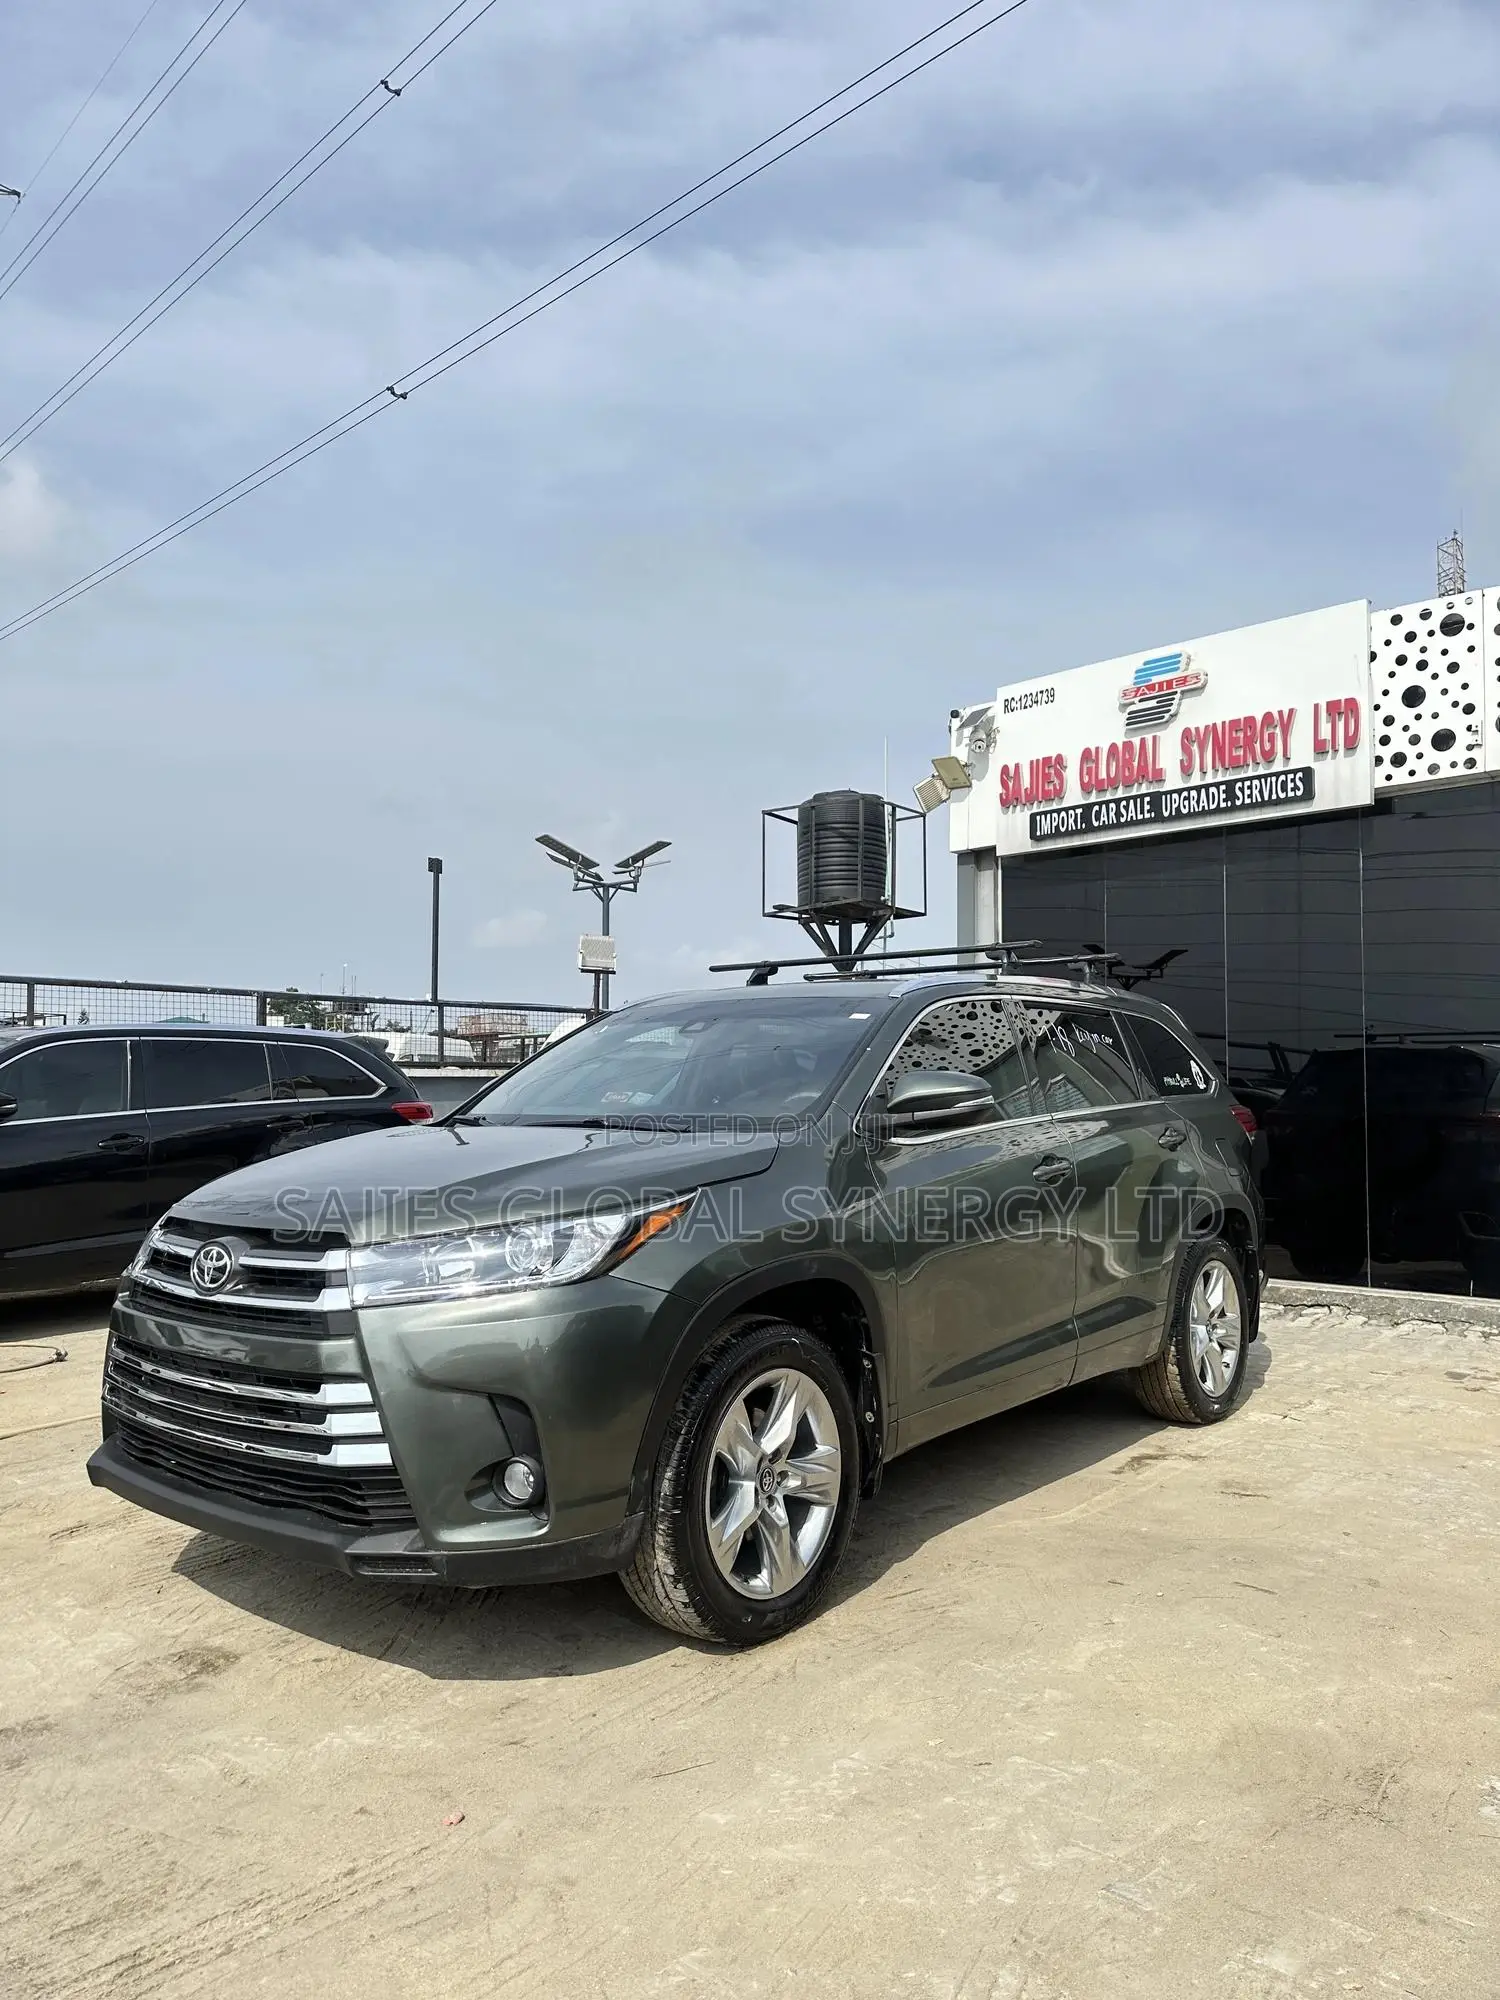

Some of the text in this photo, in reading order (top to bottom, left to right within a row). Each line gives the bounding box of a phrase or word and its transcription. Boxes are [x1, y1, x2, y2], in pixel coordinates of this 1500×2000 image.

[1003, 687, 1055, 714] RC:1234739
[1120, 671, 1202, 700] SAJIES
[999, 697, 1361, 808] SAJIES GLOBAL SYNERGY LTD
[1035, 771, 1305, 836] IMPORT. CAR SALE. UPGRADE. SERVICES
